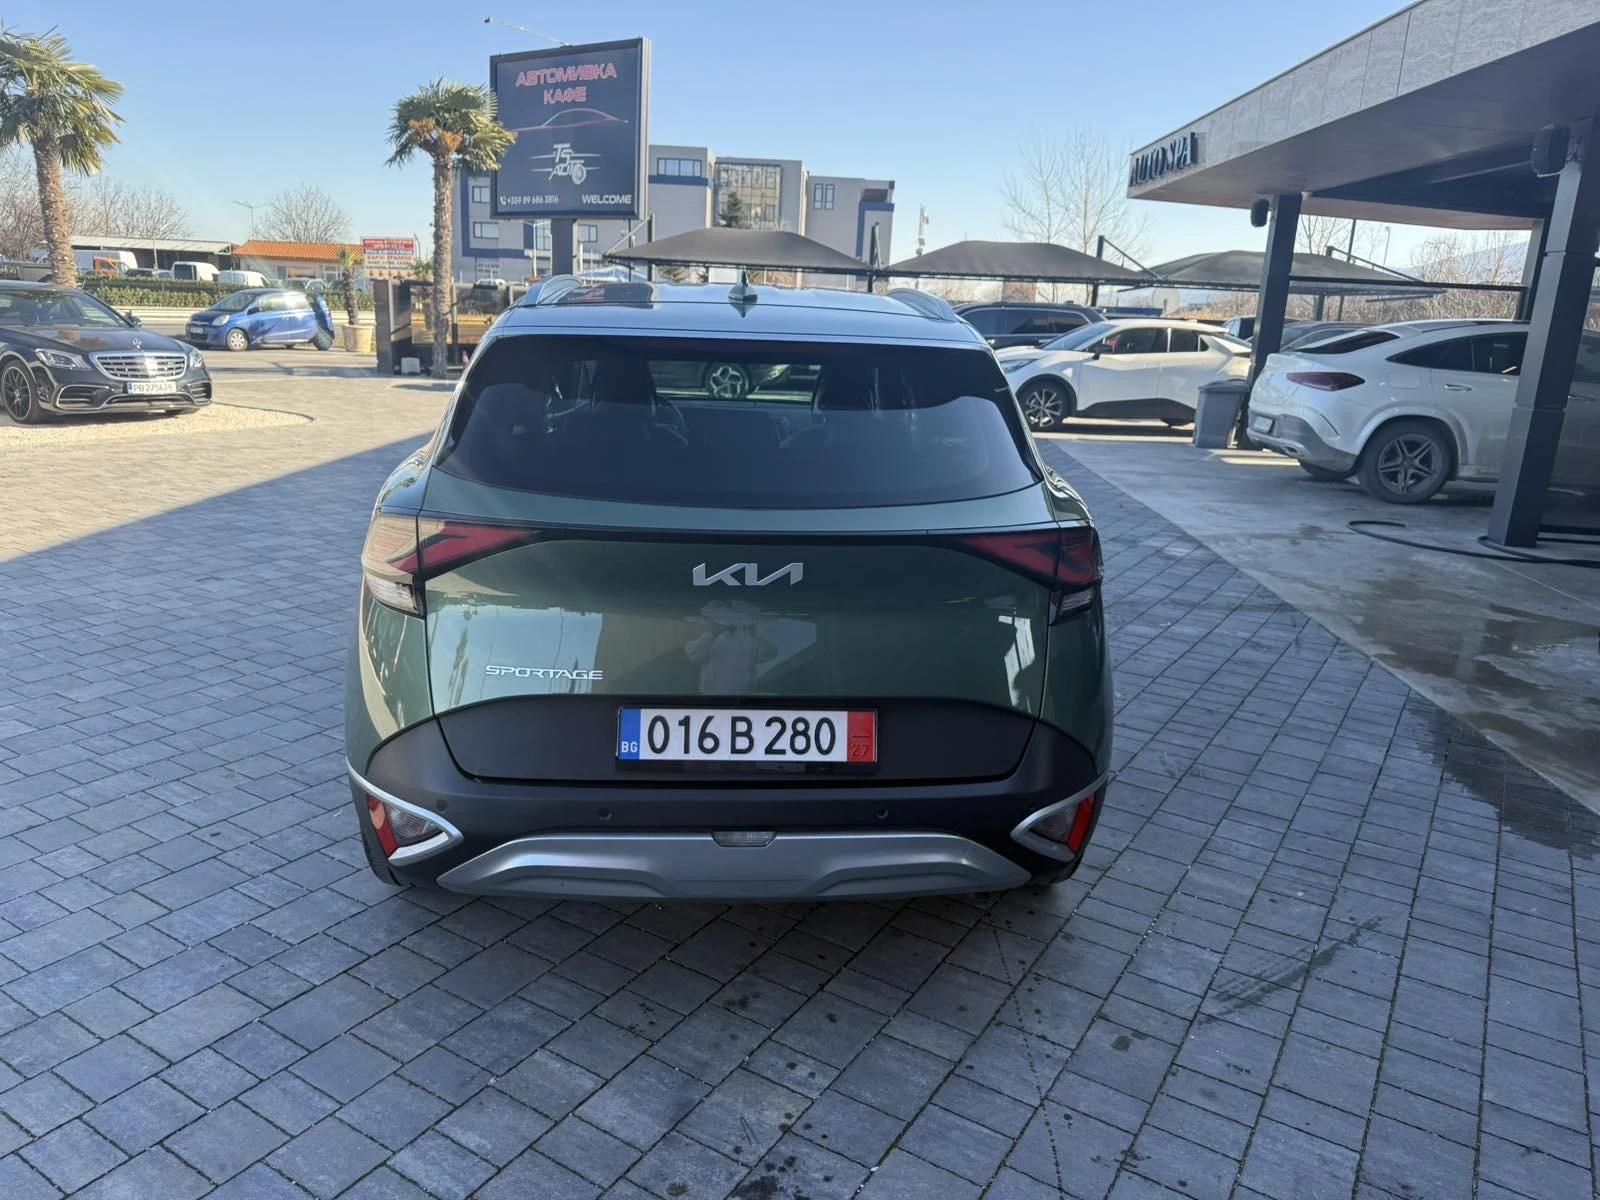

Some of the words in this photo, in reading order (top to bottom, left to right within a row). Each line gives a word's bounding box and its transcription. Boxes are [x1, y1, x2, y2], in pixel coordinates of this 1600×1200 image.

[515, 63, 617, 87] АВТОМИВКА
[543, 86, 587, 104] КАФЕ
[1167, 132, 1197, 172] SPA
[582, 194, 632, 204] WELCOME
[692, 562, 804, 585] KIA
[485, 665, 603, 680] SPORTAGE
[621, 741, 638, 753] BG
[851, 743, 869, 757] 27
